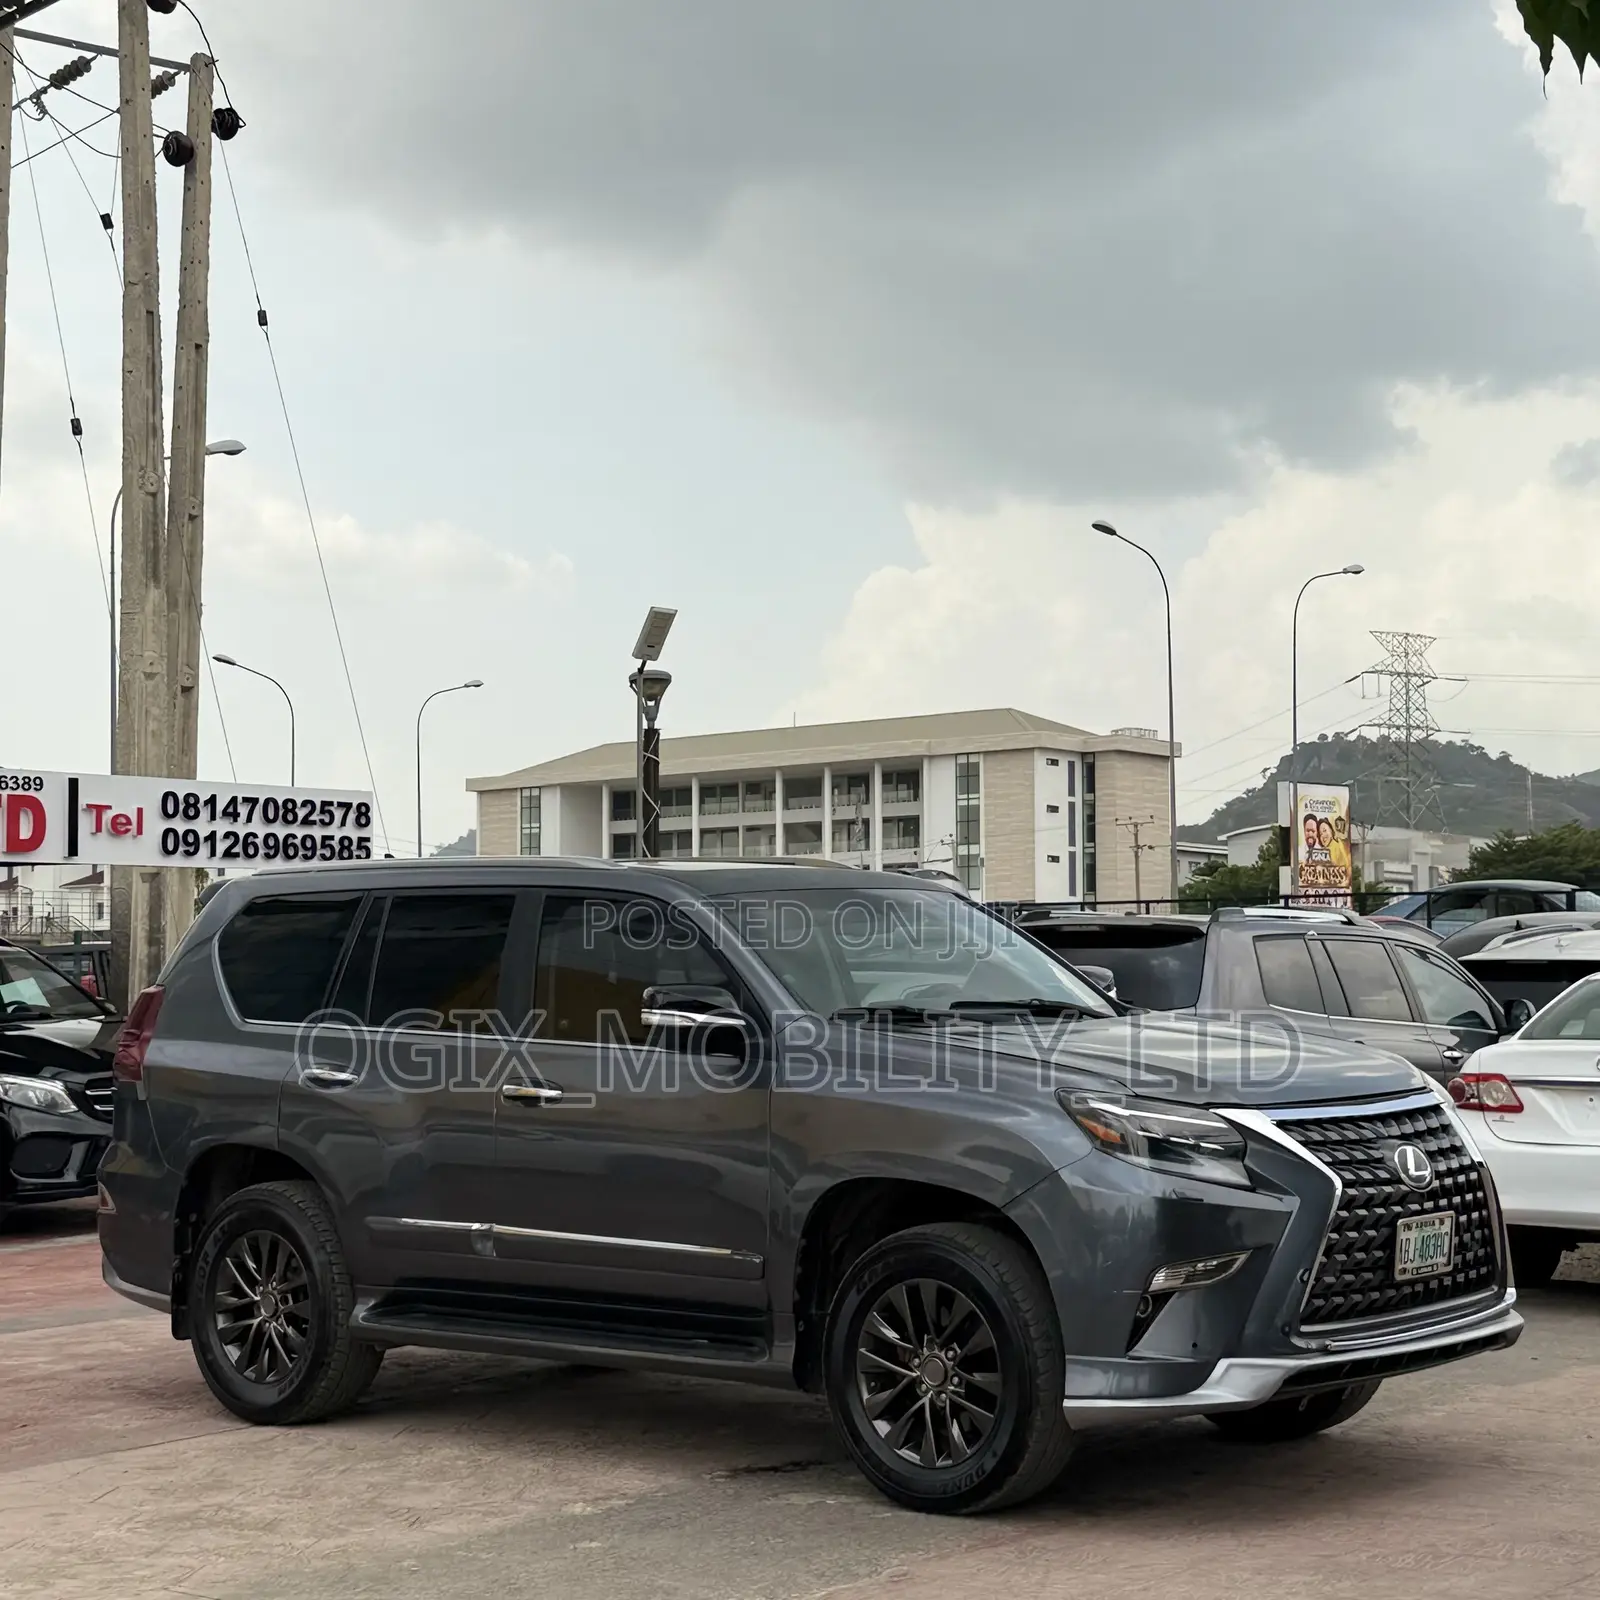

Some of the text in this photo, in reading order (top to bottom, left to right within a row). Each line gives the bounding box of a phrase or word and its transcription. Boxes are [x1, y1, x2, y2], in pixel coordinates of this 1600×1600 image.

[0, 793, 47, 853] D
[84, 803, 143, 836] Tel
[161, 790, 371, 828] 08147082578
[161, 827, 371, 860] 09126969585
